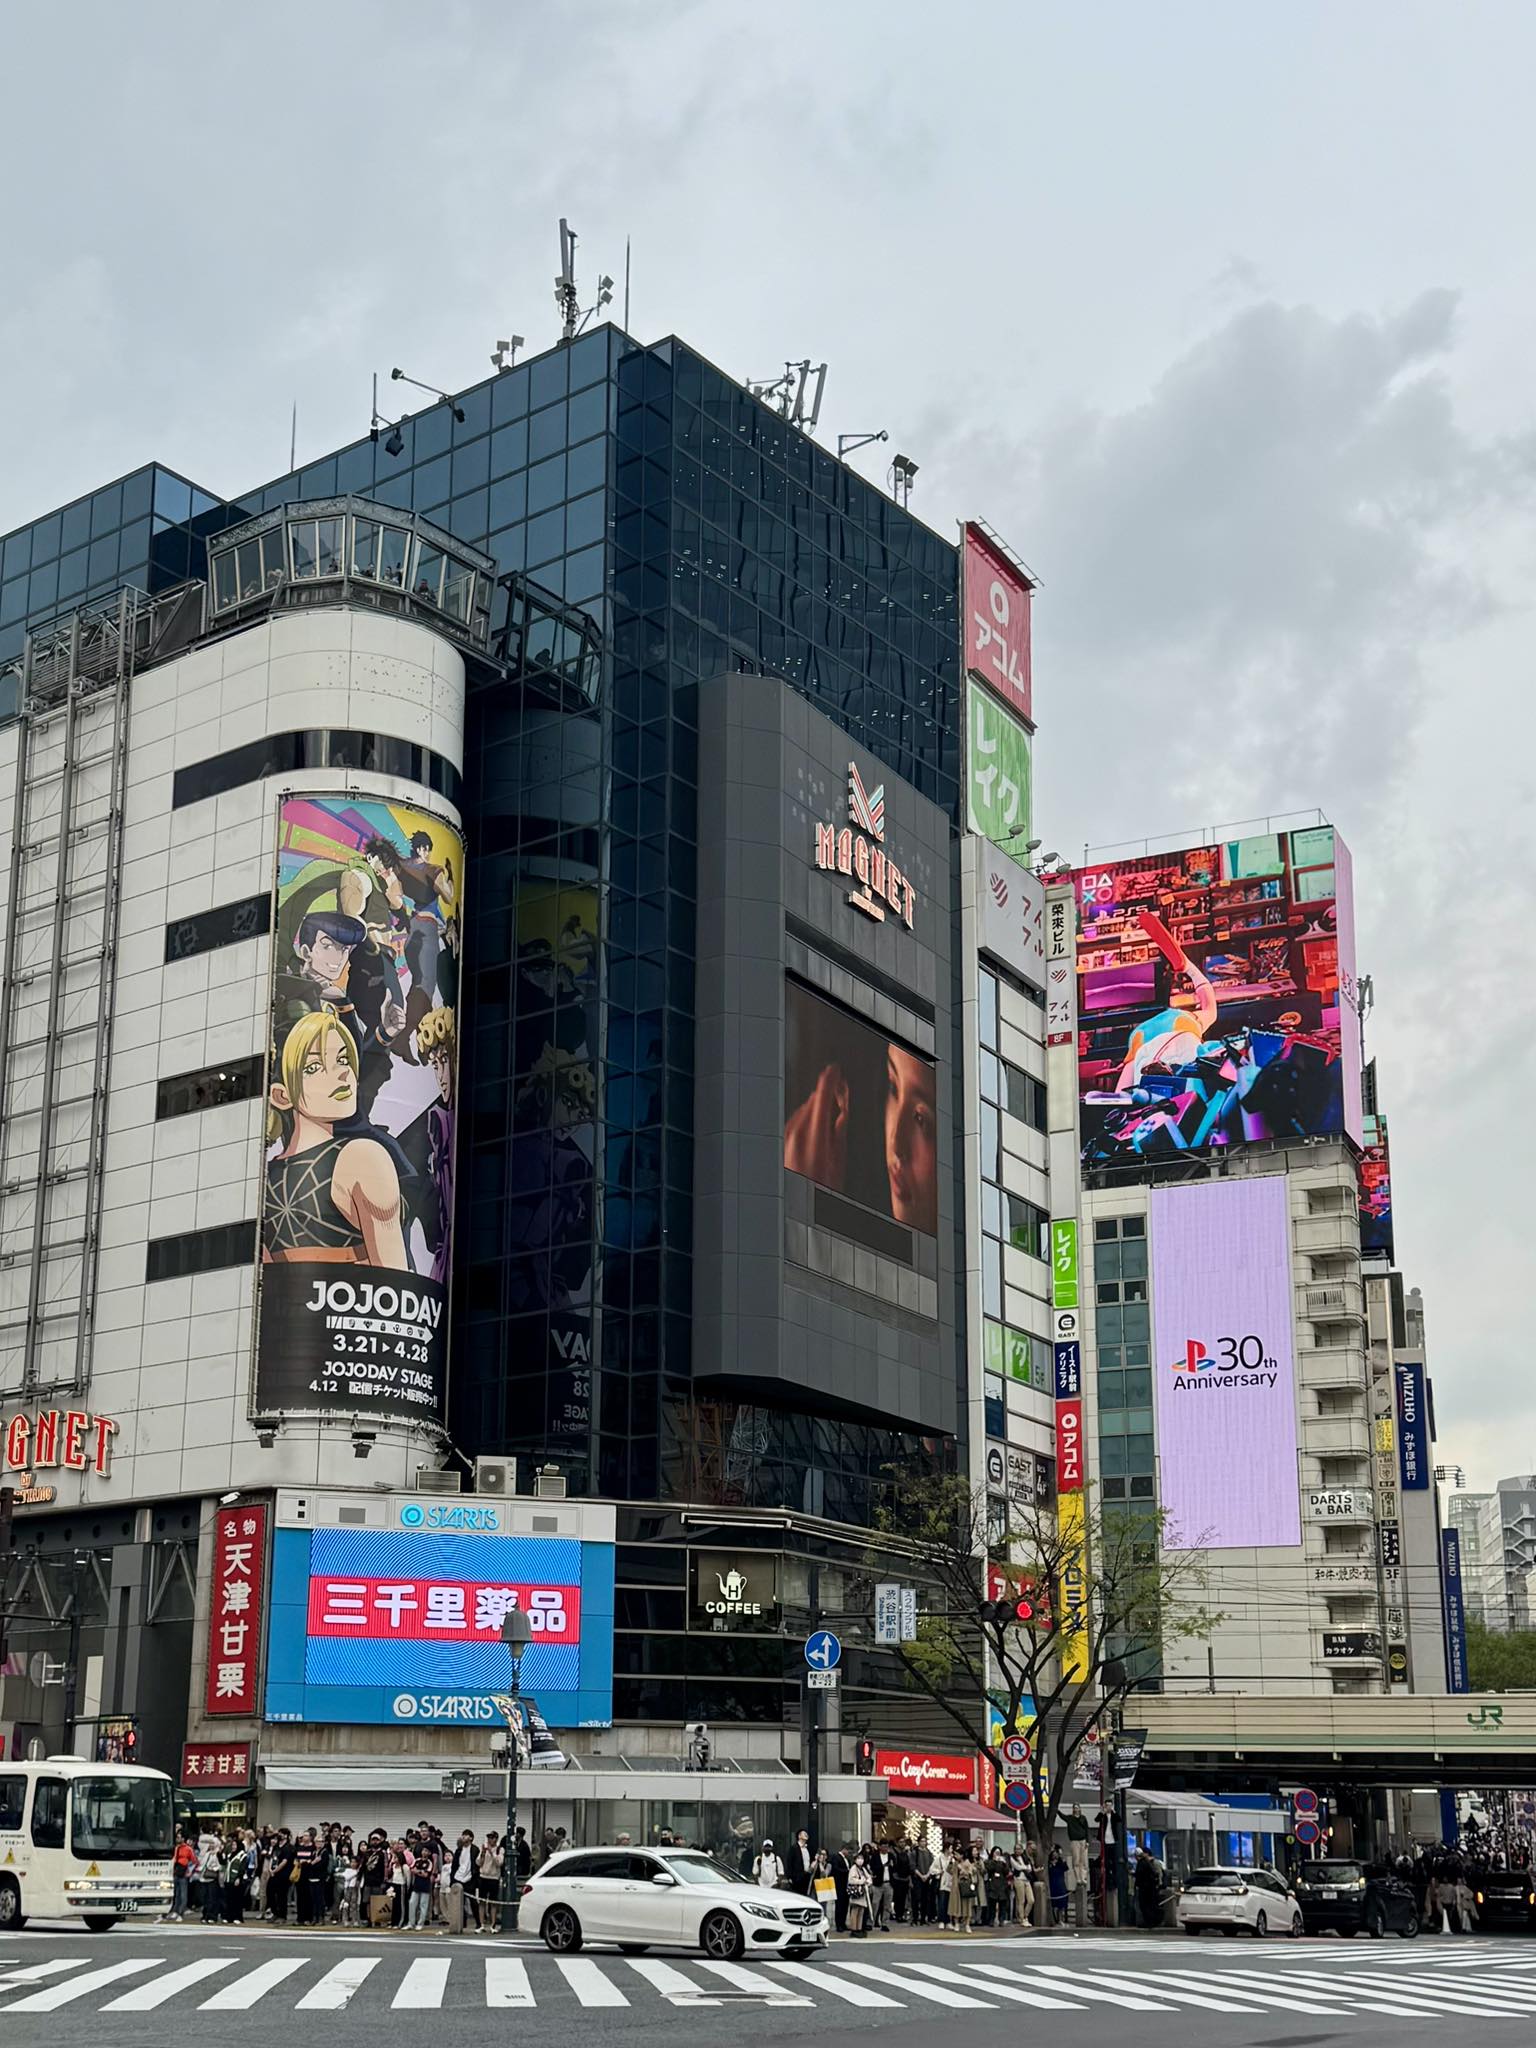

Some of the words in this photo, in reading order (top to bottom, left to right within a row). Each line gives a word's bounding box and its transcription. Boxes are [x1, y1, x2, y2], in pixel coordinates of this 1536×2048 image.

[976, 701, 1020, 824] レイク
[815, 822, 916, 930] MAGNET
[1056, 1228, 1071, 1272] レイク
[305, 1280, 442, 1329] JOJODAY
[1217, 1335, 1277, 1371] 30th
[309, 1379, 338, 1392] 4.12
[322, 1361, 398, 1381] JOJODAY
[400, 1368, 434, 1389] STAGE
[1173, 1373, 1277, 1391] Anniversary
[1403, 1373, 1415, 1423] MIZUHO
[1008, 1454, 1032, 1473] EAST
[1063, 1432, 1078, 1479] アコム
[1405, 1432, 1416, 1480] みずほ銀行
[1311, 1494, 1352, 1505] DARTS
[1327, 1504, 1353, 1515] BAR
[224, 1519, 256, 1537] 名物
[1448, 1542, 1456, 1576] MIZUHO
[1386, 1569, 1400, 1580] 3F
[216, 1542, 253, 1699] 天津甘栗
[323, 1583, 566, 1632] 三千里薬品
[705, 1601, 761, 1615] COFFEE
[886, 1589, 896, 1639] 渋谷駅前
[1326, 1647, 1354, 1655] カラオケ
[419, 1696, 493, 1720] STARTS
[1467, 1706, 1503, 1725] JR
[186, 1753, 246, 1775] 天津甘栗
